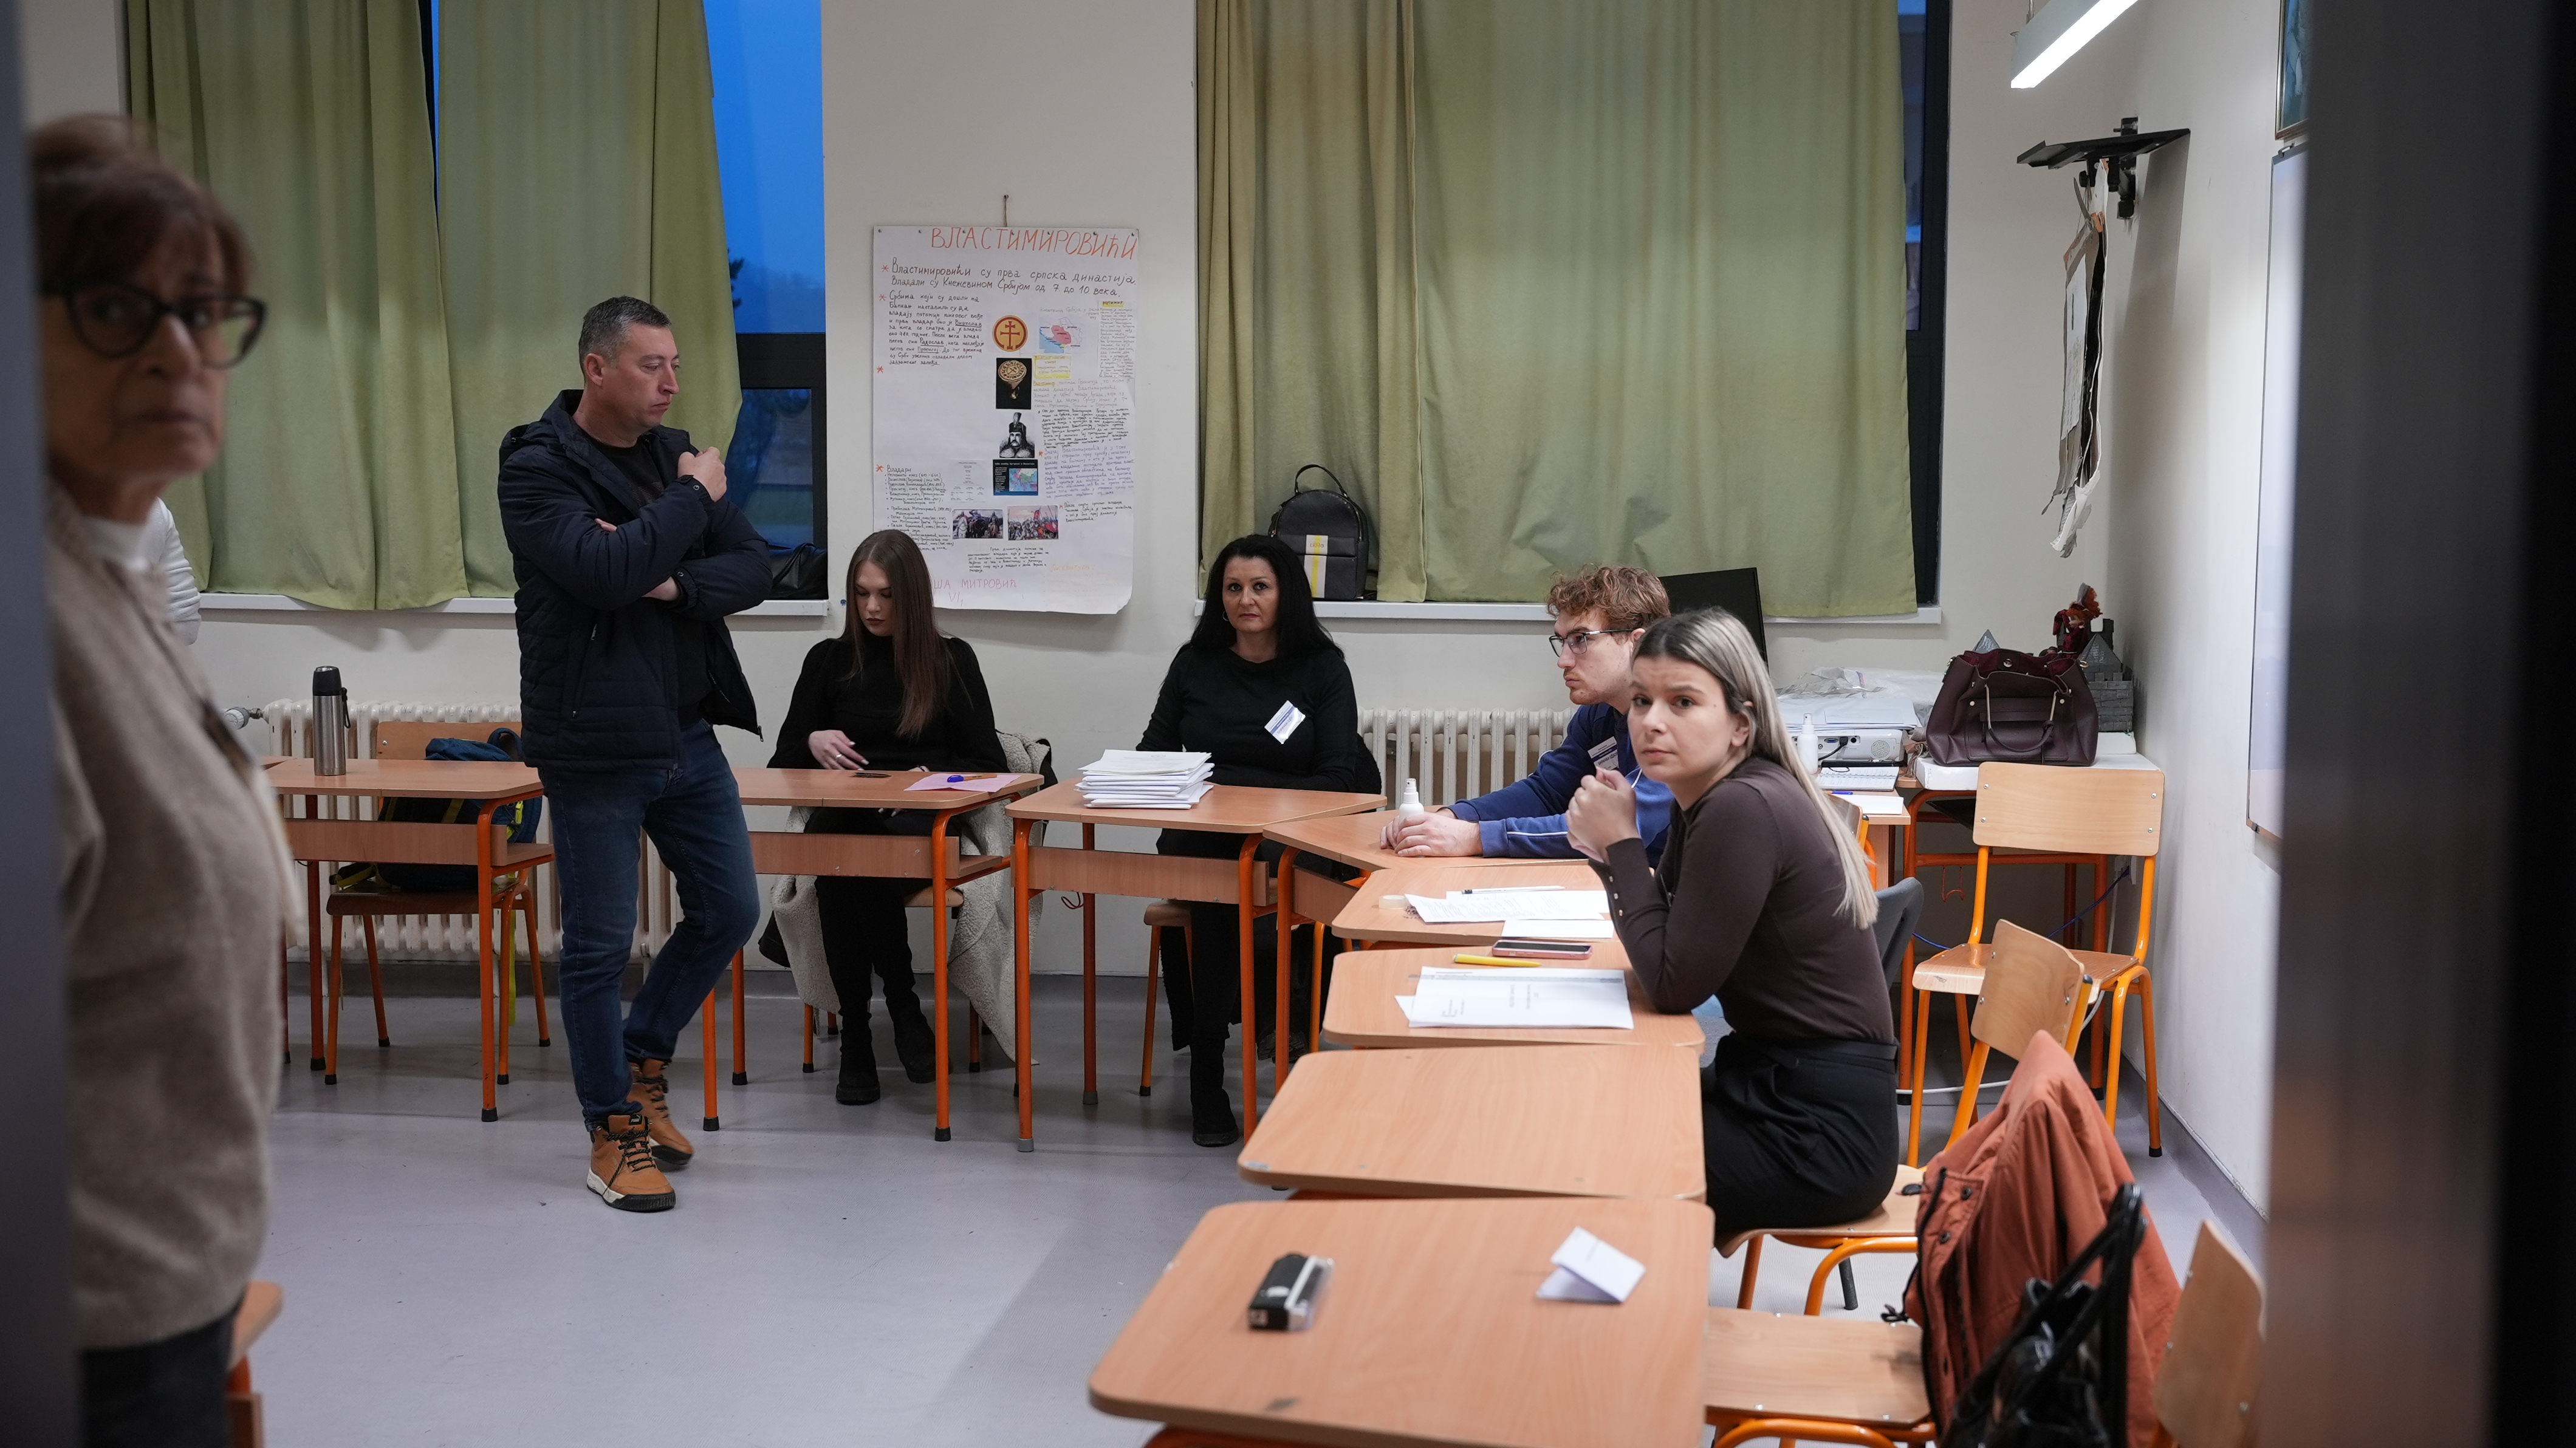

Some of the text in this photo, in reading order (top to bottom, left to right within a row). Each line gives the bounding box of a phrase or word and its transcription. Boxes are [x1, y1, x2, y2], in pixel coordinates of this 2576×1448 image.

[931, 227, 1137, 260] ВЛАСТИМИРОВИЋИ
[892, 257, 970, 280] Властимировићи
[981, 268, 991, 278] су
[998, 269, 1021, 280] прва
[1030, 271, 1067, 282] српска
[891, 275, 924, 286] Владали
[943, 276, 993, 289] Кнежевином
[998, 279, 1030, 295] Србијом
[1035, 284, 1045, 293] од
[889, 290, 914, 305] Србима
[920, 293, 933, 302] који
[961, 579, 1017, 589] МИТРОВИЋ
